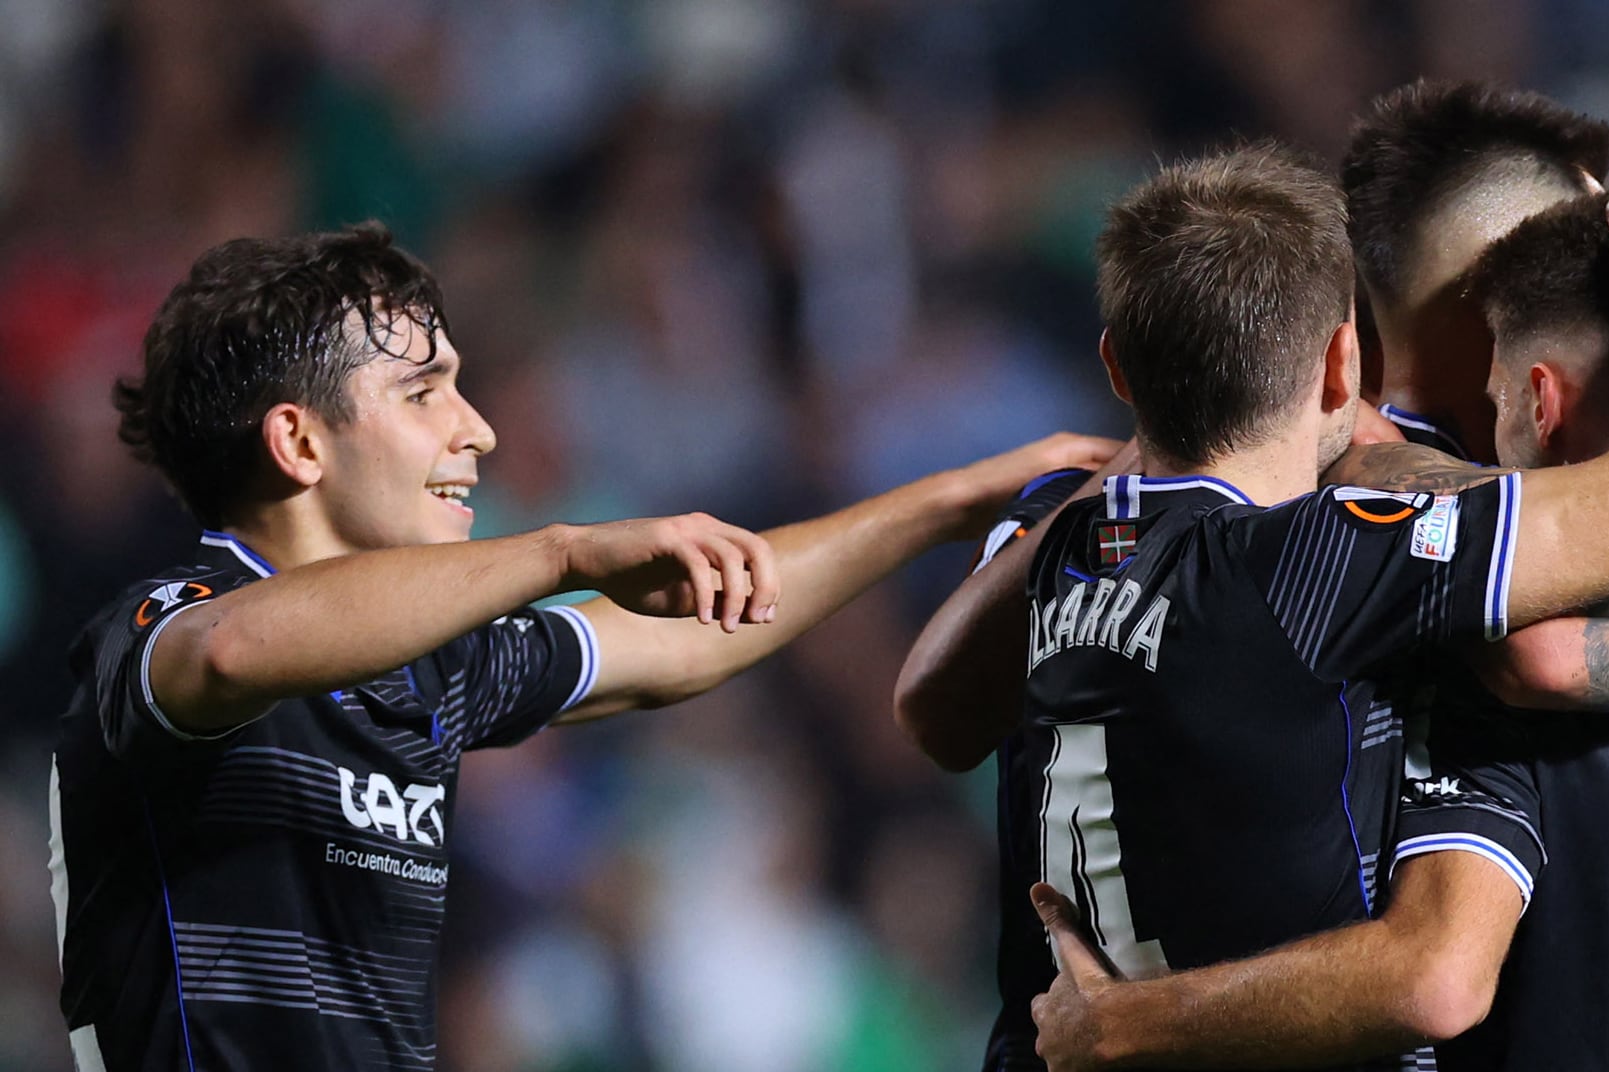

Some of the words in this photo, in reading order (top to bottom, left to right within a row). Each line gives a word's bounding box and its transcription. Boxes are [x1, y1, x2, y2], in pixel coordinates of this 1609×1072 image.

[1413, 522, 1428, 555] UEFA
[1026, 577, 1171, 680] LLARRA
[1039, 722, 1172, 982] 4
